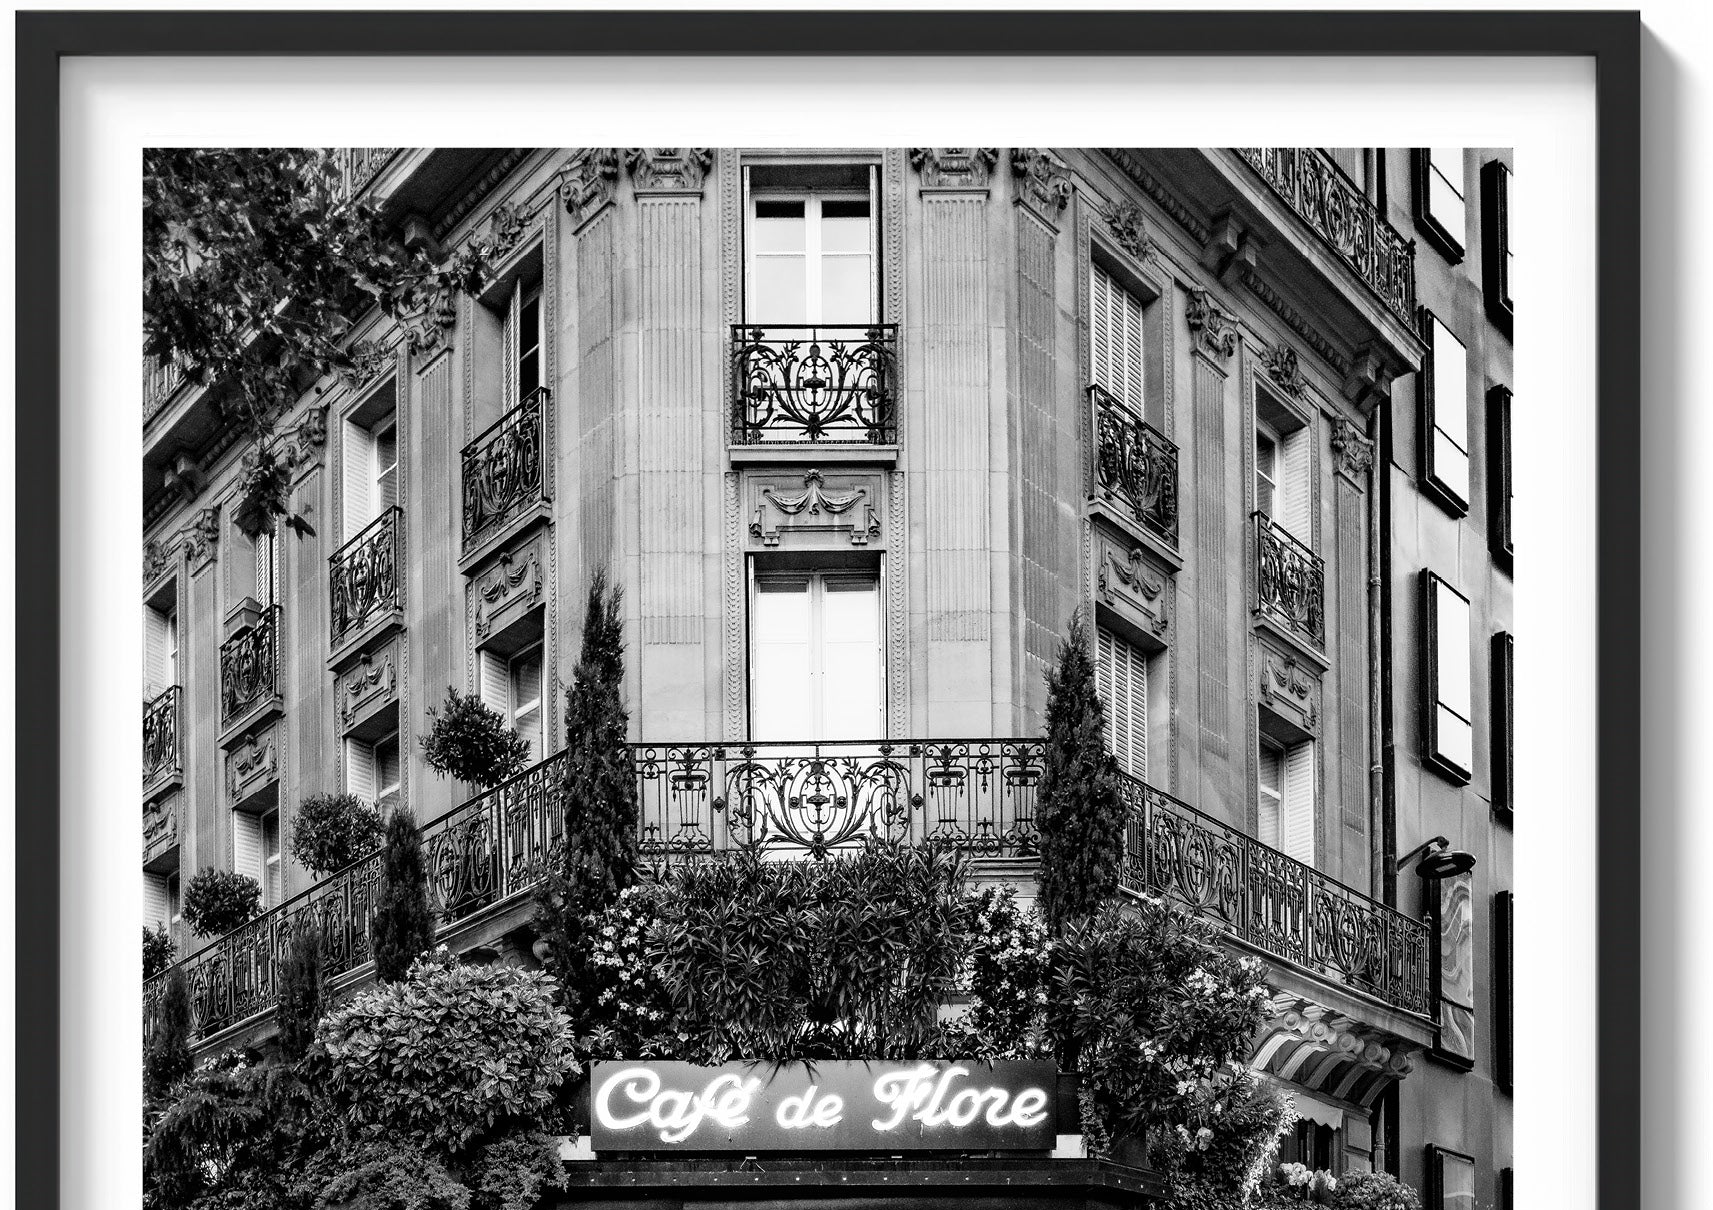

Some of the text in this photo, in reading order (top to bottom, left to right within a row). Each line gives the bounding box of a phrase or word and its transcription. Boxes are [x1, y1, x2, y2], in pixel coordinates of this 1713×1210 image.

[595, 1062, 1048, 1143] Café de Flore
